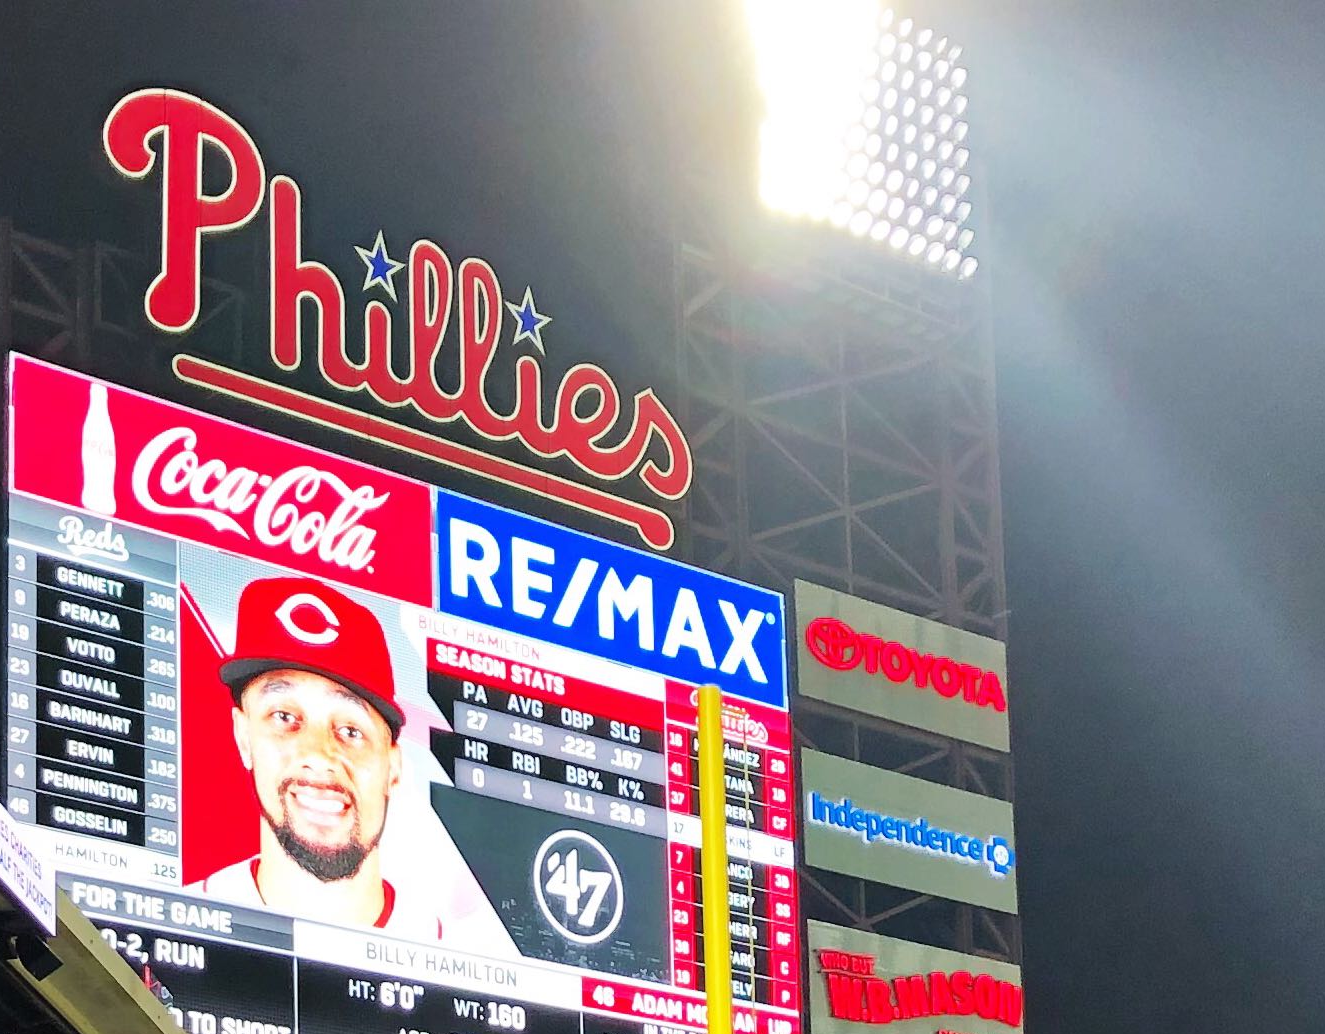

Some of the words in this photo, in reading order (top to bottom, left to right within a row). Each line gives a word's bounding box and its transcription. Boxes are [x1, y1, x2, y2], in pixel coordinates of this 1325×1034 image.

[103, 87, 693, 500] Phillies
[132, 427, 390, 574] Coca-Cola
[57, 516, 129, 561] Reds
[15, 555, 26, 571] 3
[56, 567, 124, 598] GENNETT
[146, 592, 175, 611] .306
[449, 517, 770, 685] RE/MAX
[58, 601, 120, 630] PERAZA
[146, 625, 175, 644] .214
[419, 615, 458, 636] BILLY
[466, 627, 540, 660] HAMILTON
[66, 637, 115, 663] VOTTO
[436, 644, 506, 679] SEASON
[511, 662, 565, 695] STATS
[857, 633, 1007, 713] TOYOTA
[10, 658, 30, 675] 23
[61, 670, 120, 698] DUVALL
[147, 693, 175, 711] .100
[49, 702, 132, 734] BARNHART
[147, 727, 175, 744] .318
[463, 681, 487, 704] PA
[508, 694, 544, 718] AVG
[561, 708, 593, 730] OBP
[610, 721, 641, 744] SLG
[467, 711, 488, 731] 27
[509, 722, 544, 746] .125
[561, 736, 596, 759] .222
[10, 727, 29, 743] 27
[67, 740, 114, 764] ERVIN
[15, 764, 25, 779] 4
[43, 769, 138, 804] PENNINGTON
[148, 794, 176, 812] .375
[464, 740, 488, 762] HR
[512, 752, 540, 774] RBI
[566, 766, 603, 790] BB%
[618, 778, 644, 800] K%
[53, 806, 128, 836] GOSSELIN
[148, 828, 176, 846] .250
[565, 791, 595, 814] 11.1
[809, 791, 983, 861] Independence
[55, 844, 128, 869] HAMILTON
[72, 882, 118, 911] FOR
[123, 892, 165, 922] THE
[171, 902, 233, 934] GAME
[154, 938, 205, 969] RUN
[366, 942, 417, 967] BILLY
[426, 954, 517, 987] HAMILTON
[348, 979, 375, 1001] HT:
[379, 981, 424, 1010] 6'0"
[453, 998, 484, 1020] WT:
[487, 1002, 525, 1031] 160
[632, 993, 683, 1020] ADAM
